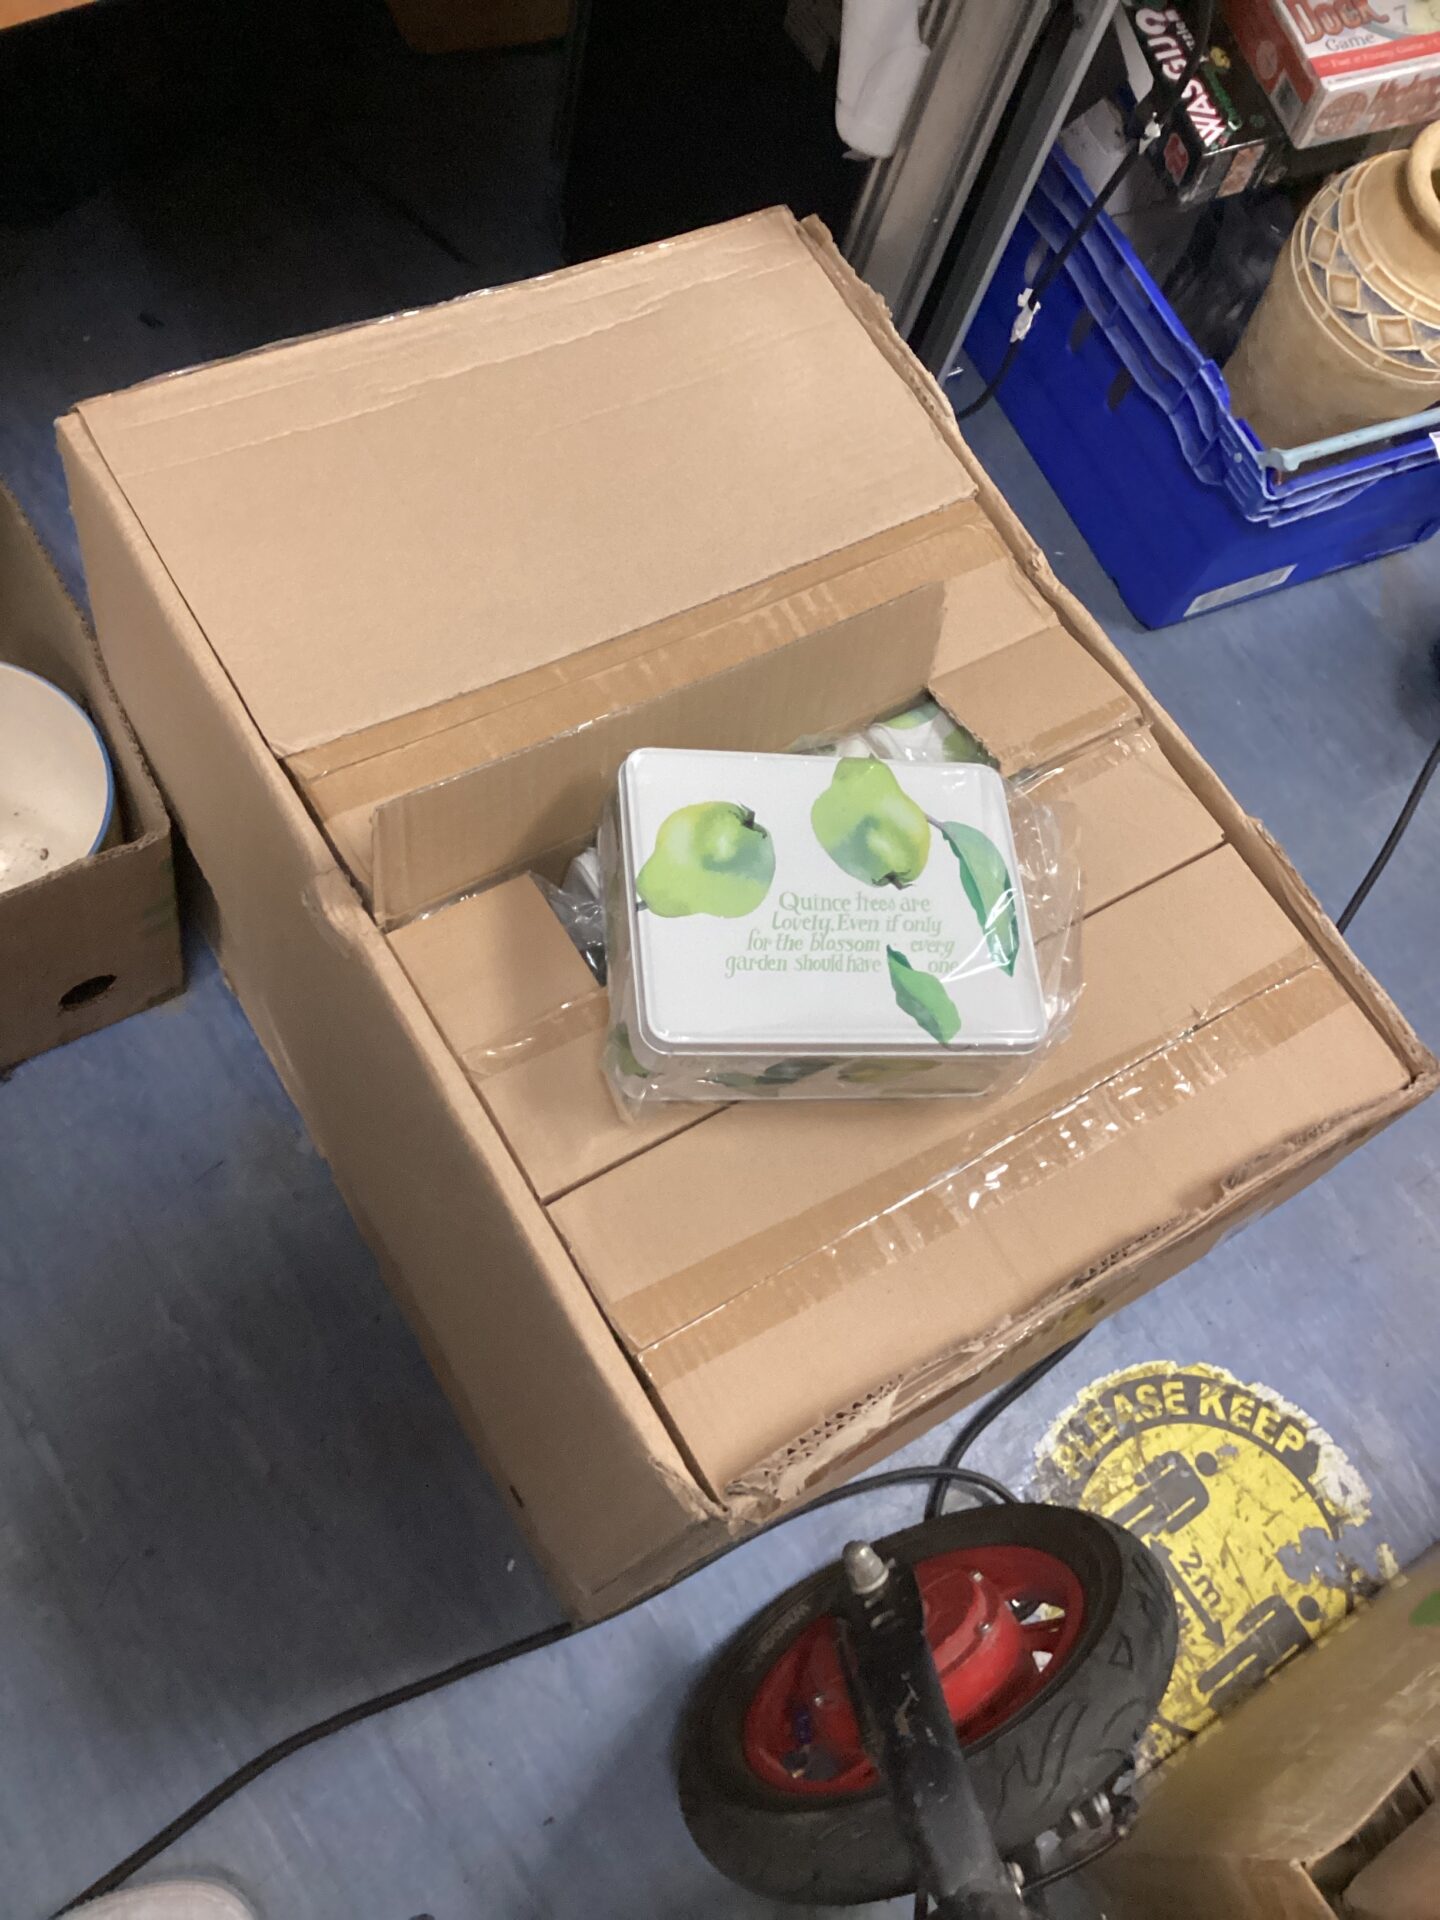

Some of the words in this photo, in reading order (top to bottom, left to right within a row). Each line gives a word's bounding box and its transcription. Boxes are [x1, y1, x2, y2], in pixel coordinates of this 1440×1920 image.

[1325, 32, 1375, 51] Game
[779, 891, 851, 915] Quince
[856, 891, 895, 912] trees
[900, 897, 930, 912] are
[886, 913, 905, 932] if
[903, 915, 943, 937] only
[747, 928, 773, 951] for
[776, 933, 804, 951] the
[810, 932, 881, 952] blossom
[725, 954, 788, 979] garden
[795, 952, 844, 972] should
[846, 952, 882, 973] have
[1052, 1380, 1189, 1480] PLEASE
[1200, 1381, 1307, 1454] KEEP
[1178, 1551, 1222, 1609] 2m
